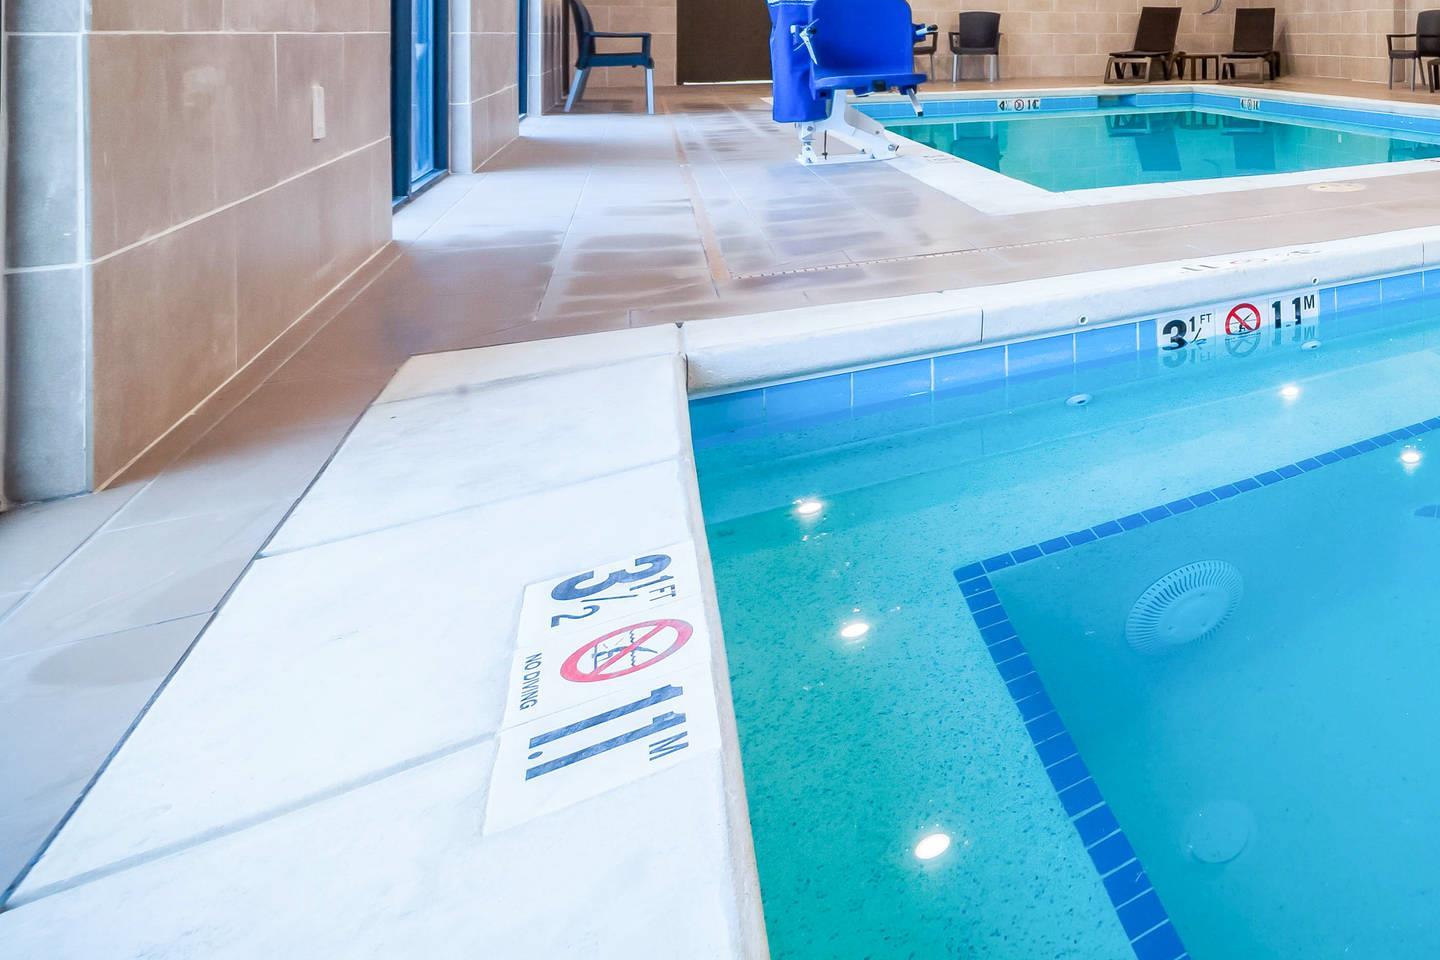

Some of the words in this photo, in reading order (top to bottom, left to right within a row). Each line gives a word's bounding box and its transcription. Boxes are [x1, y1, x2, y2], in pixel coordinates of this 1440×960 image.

[1200, 313, 1213, 325] FT
[1304, 294, 1315, 310] M
[649, 583, 677, 602] FT
[525, 652, 542, 670] NO
[520, 671, 540, 710] DIVING
[649, 730, 690, 762] M
